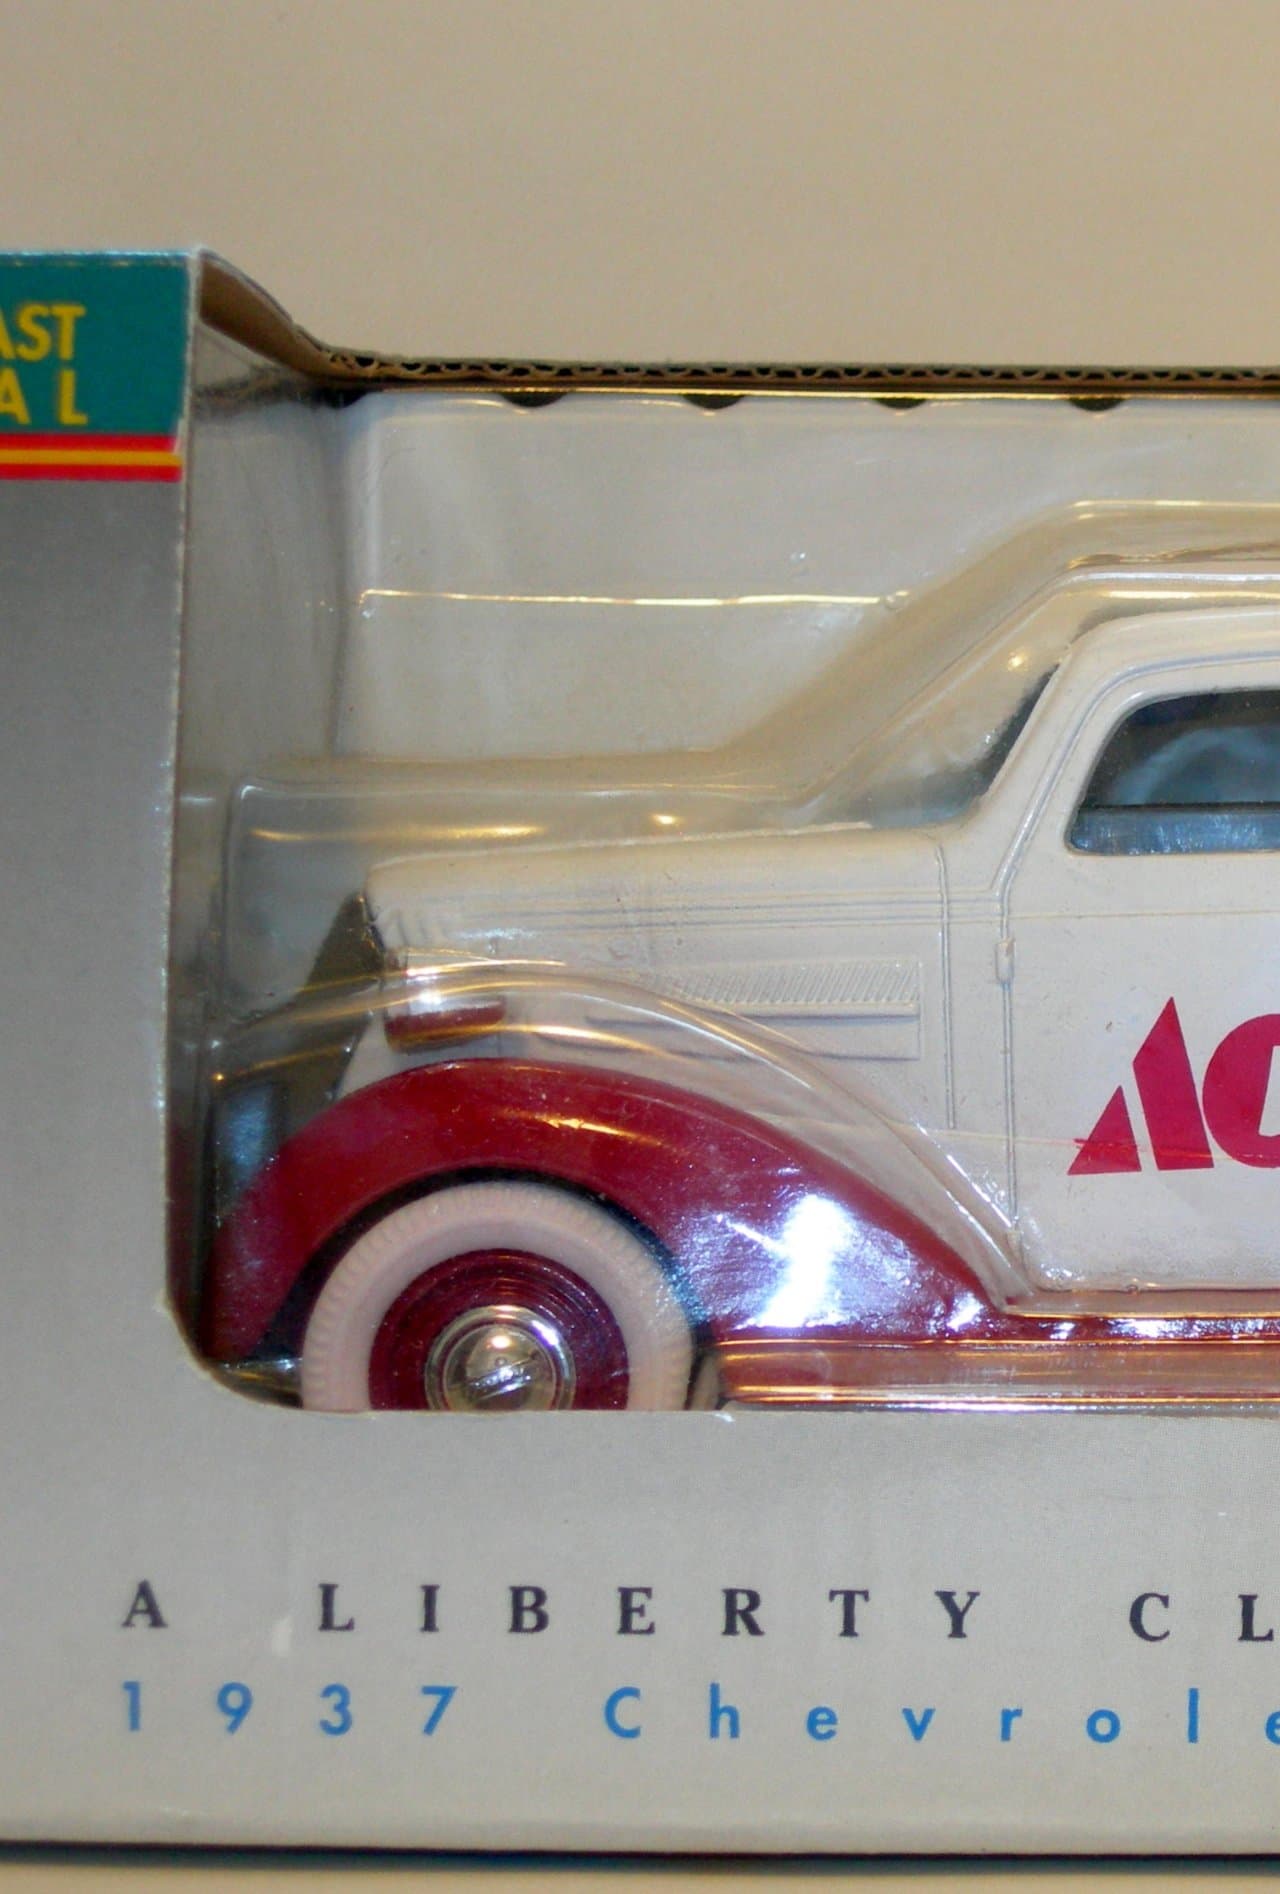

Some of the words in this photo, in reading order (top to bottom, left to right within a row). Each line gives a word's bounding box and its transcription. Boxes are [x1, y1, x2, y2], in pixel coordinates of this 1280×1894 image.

[121, 1581, 168, 1629] A
[318, 1584, 981, 1639] LIBERTY
[121, 1682, 458, 1737] 1937
